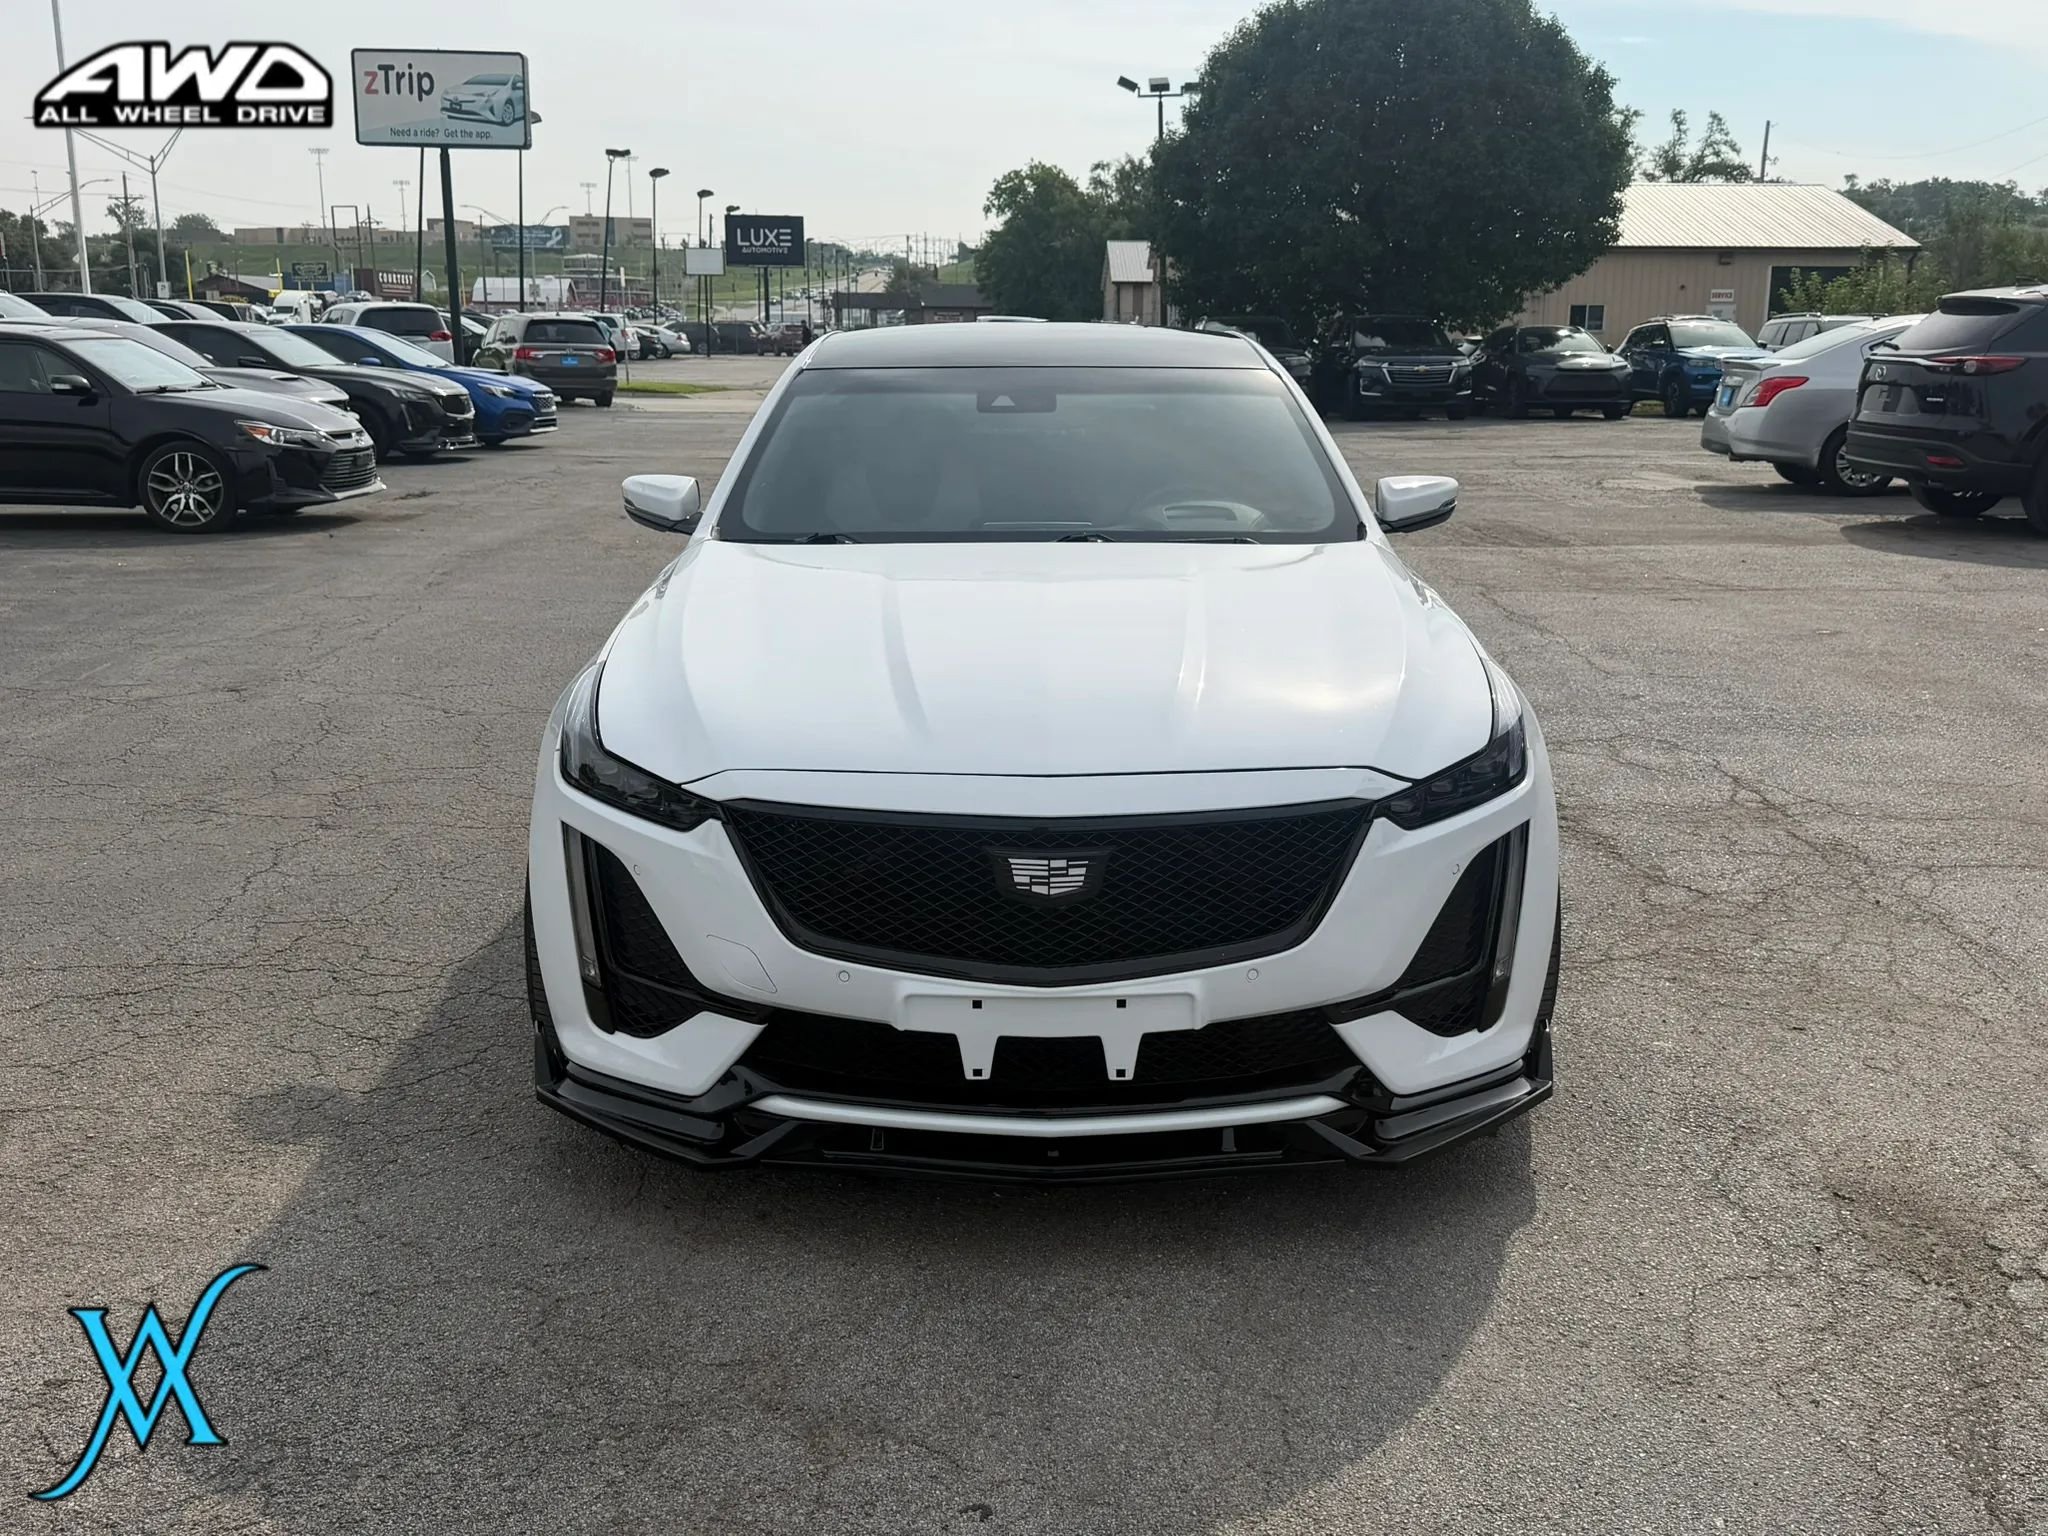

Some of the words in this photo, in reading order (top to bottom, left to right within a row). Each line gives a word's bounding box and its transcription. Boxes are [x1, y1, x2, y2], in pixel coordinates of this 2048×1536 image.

[364, 63, 435, 102] zTrip
[390, 127, 411, 137] Need
[420, 128, 440, 138] ride?
[444, 129, 458, 138] Get
[460, 129, 473, 138] the
[476, 131, 493, 140] app.
[737, 228, 792, 246] LUXE
